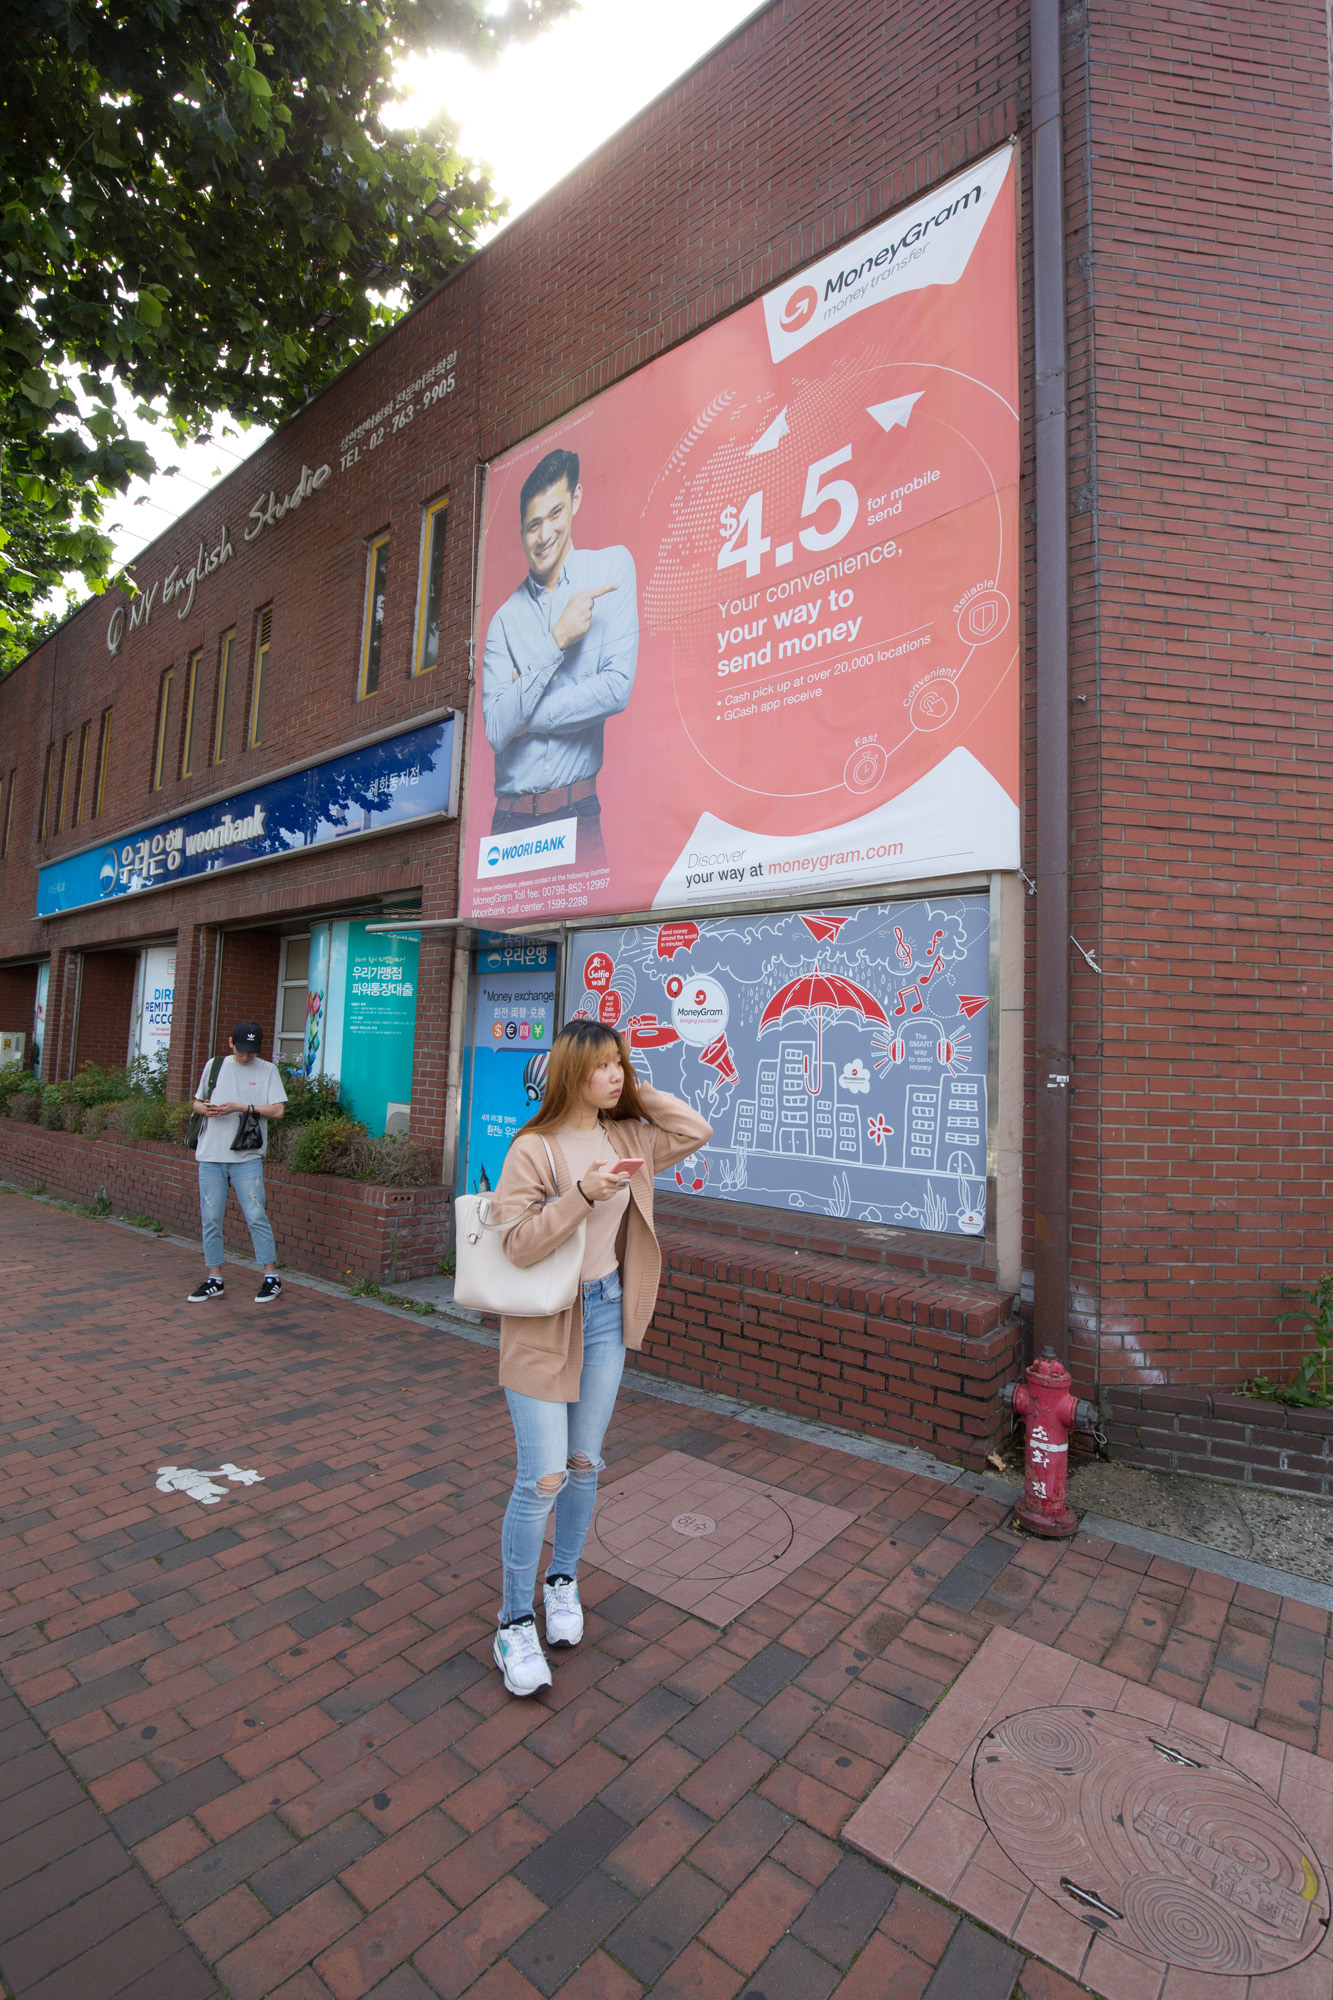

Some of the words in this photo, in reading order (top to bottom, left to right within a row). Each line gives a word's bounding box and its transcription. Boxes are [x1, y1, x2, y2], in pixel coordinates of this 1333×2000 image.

[824, 185, 982, 301] MoneyGram
[823, 283, 869, 321] money
[870, 241, 930, 288] transfer
[867, 496, 887, 511] for
[890, 469, 941, 500] mobile
[867, 500, 902, 526] send
[129, 581, 159, 630] NY
[163, 525, 235, 620] English
[244, 464, 332, 541] Studio
[717, 591, 761, 618] Your
[766, 540, 903, 603] convenience,
[952, 579, 995, 614] Reliable
[717, 617, 768, 653] your
[773, 598, 822, 630] way
[828, 588, 855, 611] to
[717, 641, 771, 677] send
[778, 616, 862, 660] money
[725, 690, 750, 706] Cash
[752, 684, 774, 700] pick
[777, 681, 791, 695] up
[793, 675, 804, 688] at
[807, 668, 831, 683] over
[834, 653, 874, 676] 20,000
[877, 633, 931, 662] locations
[902, 666, 956, 708] Convenient
[724, 703, 758, 722] GCash
[761, 699, 780, 713] app
[783, 687, 823, 706] receive
[854, 733, 878, 748] Fast
[368, 763, 420, 796] 혜화동지점
[119, 828, 184, 884] 우리은행
[501, 842, 534, 861] WOORI
[534, 835, 567, 855] BANK
[685, 871, 715, 888] your
[717, 866, 745, 882] way
[749, 861, 764, 877] at
[768, 841, 904, 876] moneygram.com
[687, 848, 748, 869] Discover
[506, 902, 519, 914] call
[547, 895, 588, 910] 1599-2288
[514, 890, 526, 900] Toll
[541, 877, 611, 897] 00798-852-12997
[502, 946, 547, 966] 우리은행
[351, 982, 414, 997] 파워통장대출
[352, 966, 403, 980] 우리가맹점
[588, 969, 610, 978] Selfie
[591, 978, 606, 986] wall
[514, 990, 554, 1003] exchange
[677, 1007, 723, 1018] MoneyGram
[910, 1064, 931, 1072] money
[1031, 1425, 1050, 1499] 소화전
[678, 1515, 707, 1531] 하수
[1138, 1815, 1204, 1858] SEOUL
